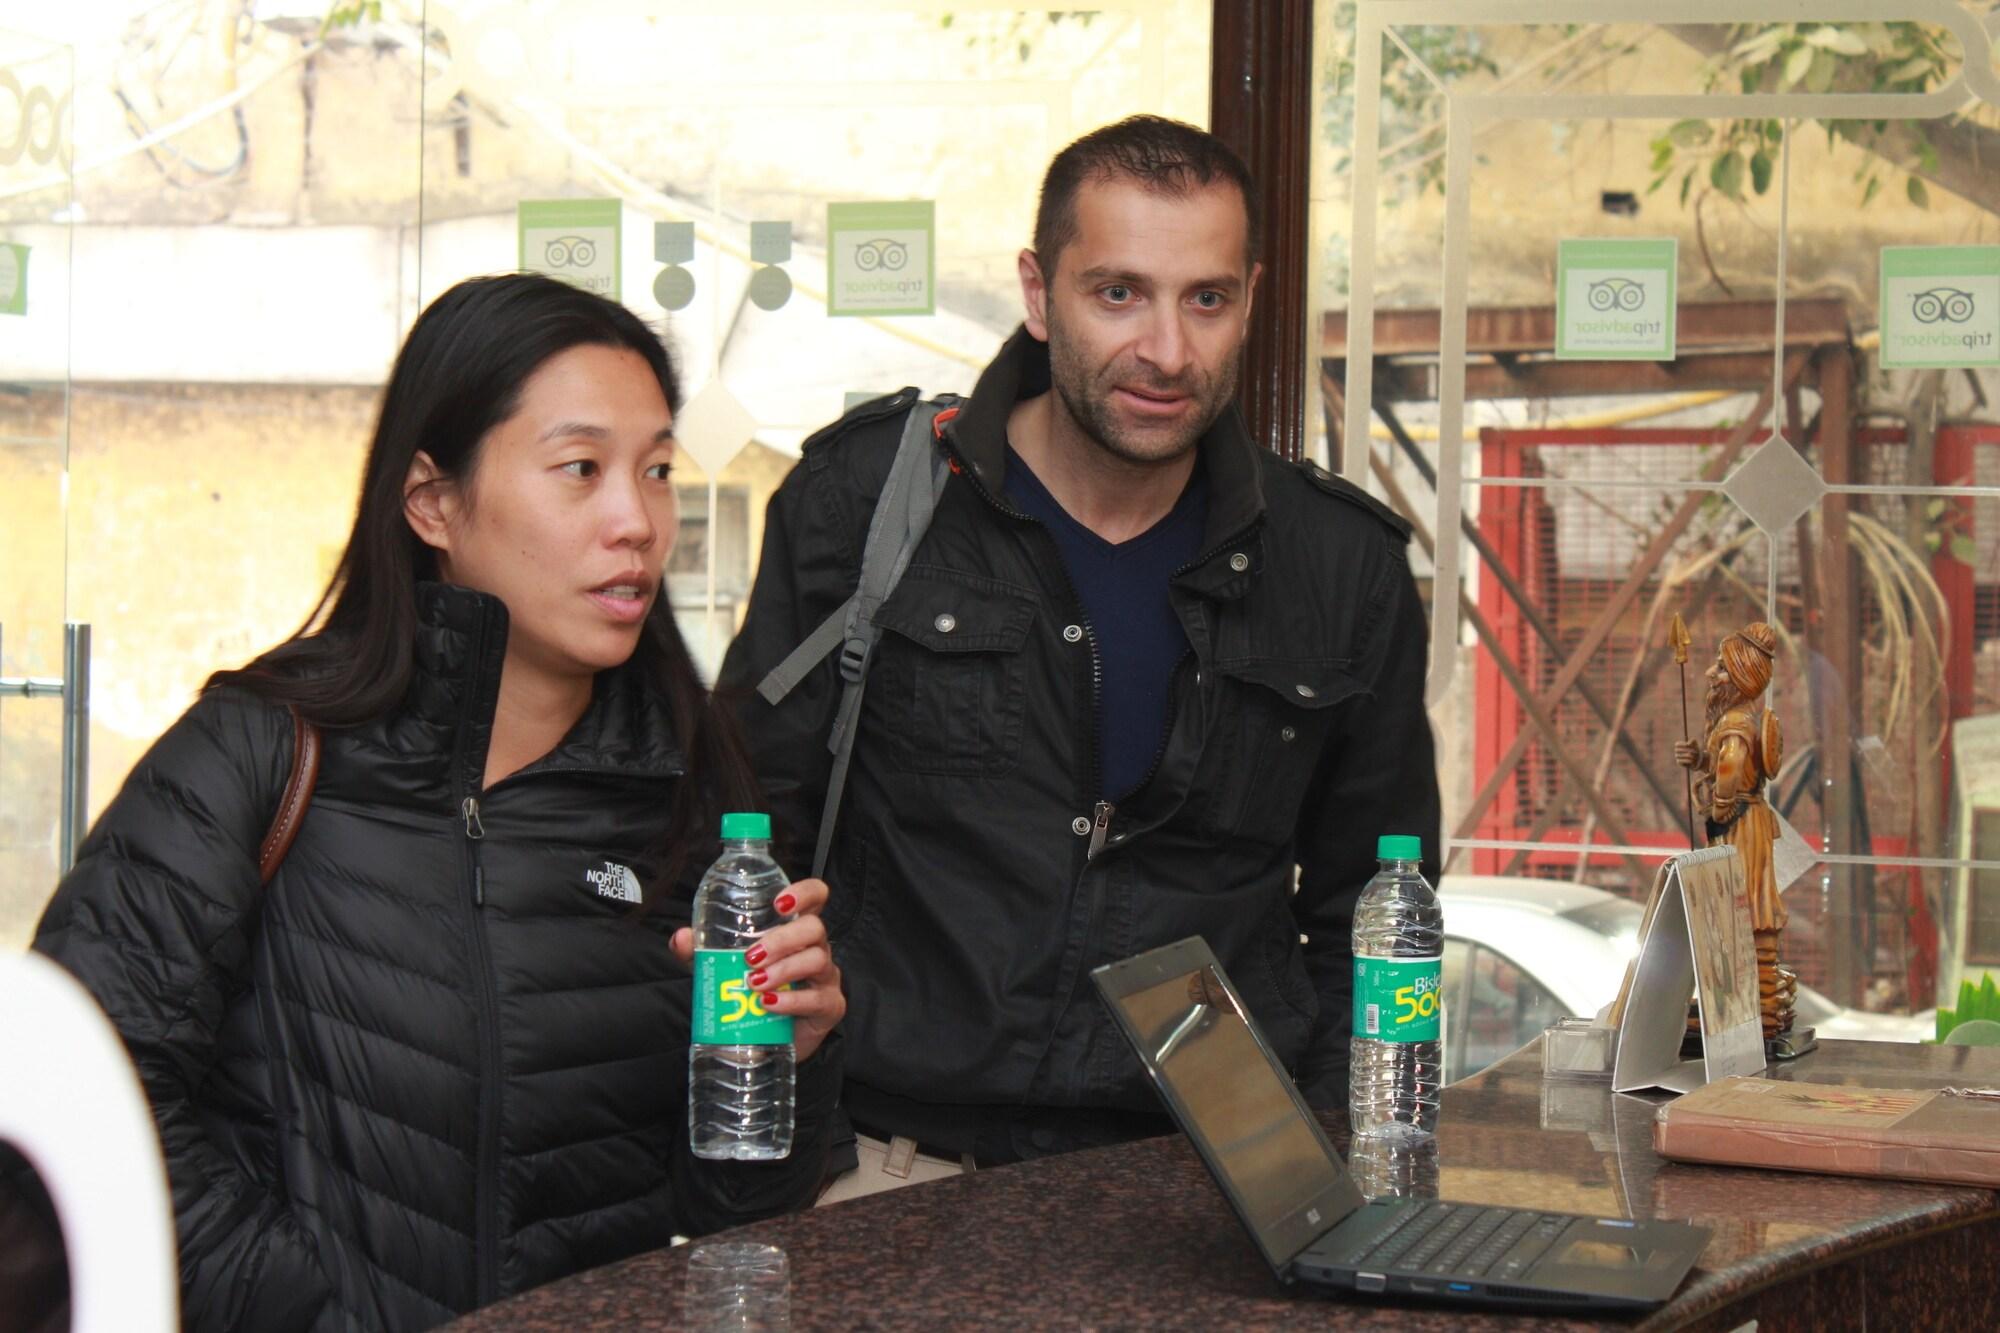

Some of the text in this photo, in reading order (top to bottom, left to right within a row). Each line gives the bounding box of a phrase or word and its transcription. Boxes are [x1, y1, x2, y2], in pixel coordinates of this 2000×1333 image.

[604, 861, 624, 876] THE
[586, 869, 624, 887] NORTH
[598, 883, 625, 900] FACE
